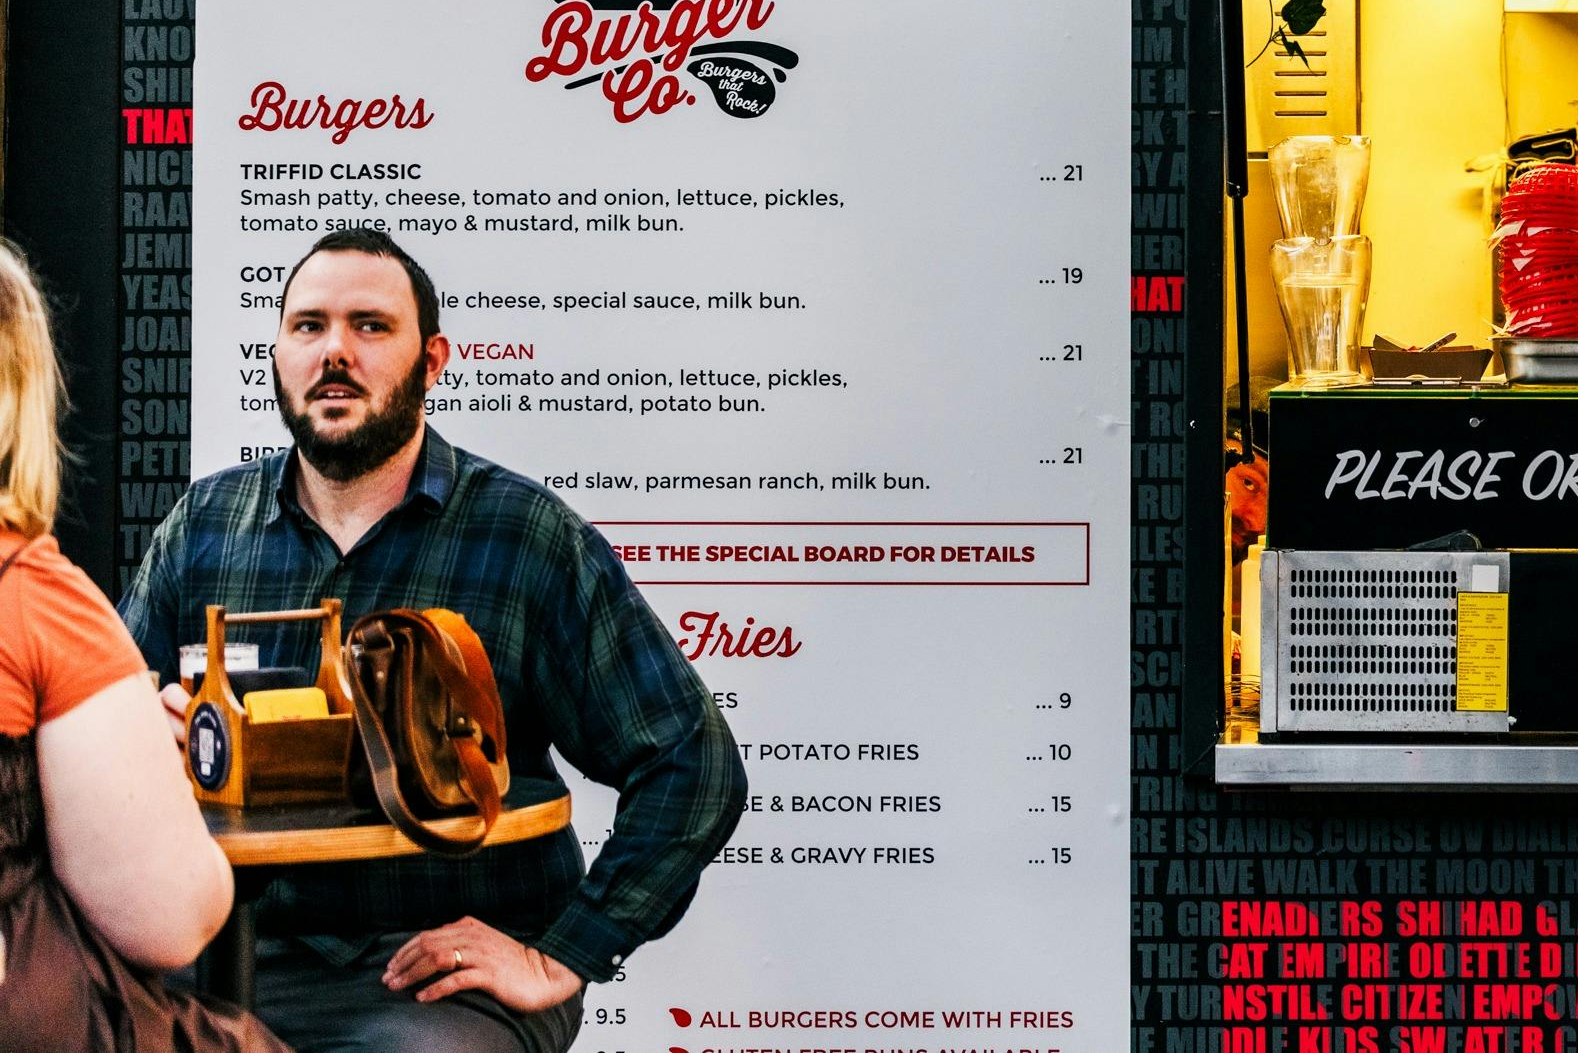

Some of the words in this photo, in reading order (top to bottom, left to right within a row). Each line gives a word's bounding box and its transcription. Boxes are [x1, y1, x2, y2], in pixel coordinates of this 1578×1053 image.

[698, 62, 766, 85] Burgers
[603, 59, 696, 123] Co.
[719, 78, 742, 92] that
[727, 91, 765, 114] Rock!
[239, 82, 434, 144] Burgers
[241, 164, 323, 179] TRIFFID
[331, 164, 421, 179] CLASSIC
[1064, 165, 1082, 181] 21
[241, 189, 309, 205] Smash
[319, 190, 377, 209] patty,
[386, 189, 465, 206] cheese,
[473, 190, 550, 205] tomato
[558, 189, 596, 205] and
[604, 189, 669, 206] onion,
[678, 189, 757, 206] lettuce,
[766, 189, 843, 209] pickles,
[241, 216, 317, 231] tomato
[323, 219, 391, 235] sauce,
[400, 219, 457, 235] mayo
[465, 215, 477, 231] &
[486, 215, 578, 231] mustard,
[587, 215, 630, 231] milk
[638, 215, 683, 231] bun.
[241, 267, 285, 282] GOT
[1063, 268, 1082, 283] 19
[466, 292, 545, 308] cheese,
[554, 292, 625, 312] special
[634, 296, 699, 309] sauce,
[709, 292, 751, 308] milk
[760, 292, 805, 308] bun.
[458, 344, 533, 359] VEGAN
[1064, 345, 1081, 360] 21
[240, 370, 265, 385] V2
[477, 370, 553, 385] tomato
[561, 369, 599, 385] and
[608, 369, 672, 387] onion,
[681, 369, 760, 387] lettuce,
[769, 370, 847, 389] pickles,
[469, 395, 510, 411] aioli
[519, 396, 531, 411] &
[540, 395, 632, 412] mustard,
[641, 396, 711, 415] potato
[720, 395, 764, 411] bun.
[1064, 448, 1081, 463] 21
[545, 472, 577, 488] red
[586, 472, 638, 490] slaw,
[647, 477, 750, 492] parmesan
[760, 473, 823, 490] ranch,
[832, 473, 876, 489] milk
[884, 473, 929, 489] bun.
[1325, 450, 1515, 500] PLEASE
[612, 544, 651, 563] SEE
[656, 546, 700, 561] THE
[706, 546, 799, 561] SPECIAL
[805, 546, 885, 562] BOARD
[891, 546, 935, 562] FOR
[941, 546, 1034, 562] DETAILS
[678, 612, 802, 660] Fries
[1060, 693, 1071, 708] 9
[761, 744, 850, 760] POTATO
[859, 744, 918, 760] FRIES
[1050, 744, 1071, 760] 10
[771, 796, 783, 811] &
[792, 796, 871, 812] BACON
[881, 796, 940, 812] FRIES
[1052, 796, 1071, 812] 15
[1176, 818, 1313, 853] ISLANDS
[771, 848, 783, 863] &
[792, 848, 866, 863] GRAVY
[874, 848, 934, 863] FRIES
[1052, 848, 1071, 863] 15
[1166, 859, 1255, 895] ALIVE
[1263, 859, 1358, 895] WALK
[1365, 859, 1426, 895] THE
[1436, 859, 1536, 895] MOON
[1177, 901, 1382, 937] GRENADIERS
[1396, 901, 1522, 937] SHIHAD
[1140, 943, 1197, 979] THE
[1207, 943, 1268, 979] CAT
[1278, 943, 1399, 979] EMPIRE
[1410, 943, 1531, 979] ODETTE
[1161, 985, 1333, 1020] TURNSTILE
[1341, 985, 1465, 1020] CITIZEN
[596, 1009, 625, 1024] 9.5
[700, 1012, 740, 1027] ALL
[749, 1011, 857, 1028] BURGERS
[865, 1011, 934, 1028] COME
[942, 1012, 1000, 1028] WITH
[1011, 1012, 1073, 1028] FRIES
